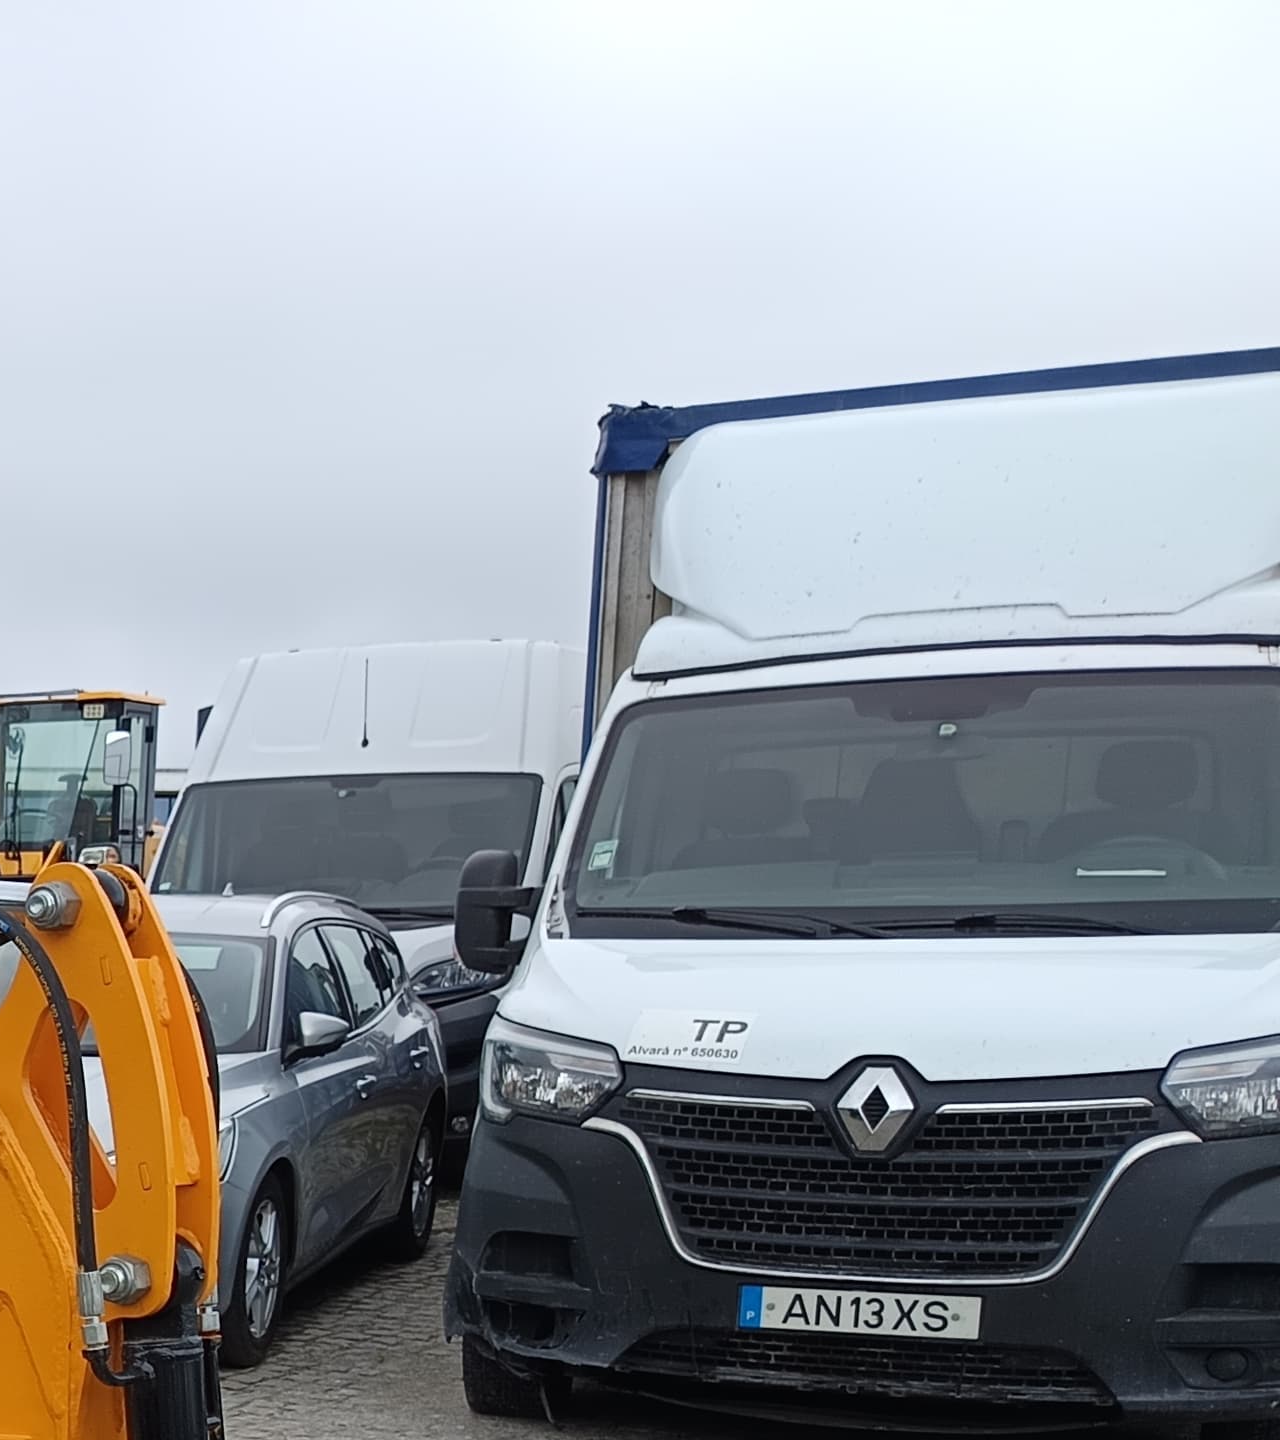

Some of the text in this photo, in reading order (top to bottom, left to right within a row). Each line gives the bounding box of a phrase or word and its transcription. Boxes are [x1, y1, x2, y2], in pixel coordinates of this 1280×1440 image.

[693, 1019, 748, 1043] TP
[627, 1045, 670, 1056] Alvará
[691, 1047, 738, 1059] 650630
